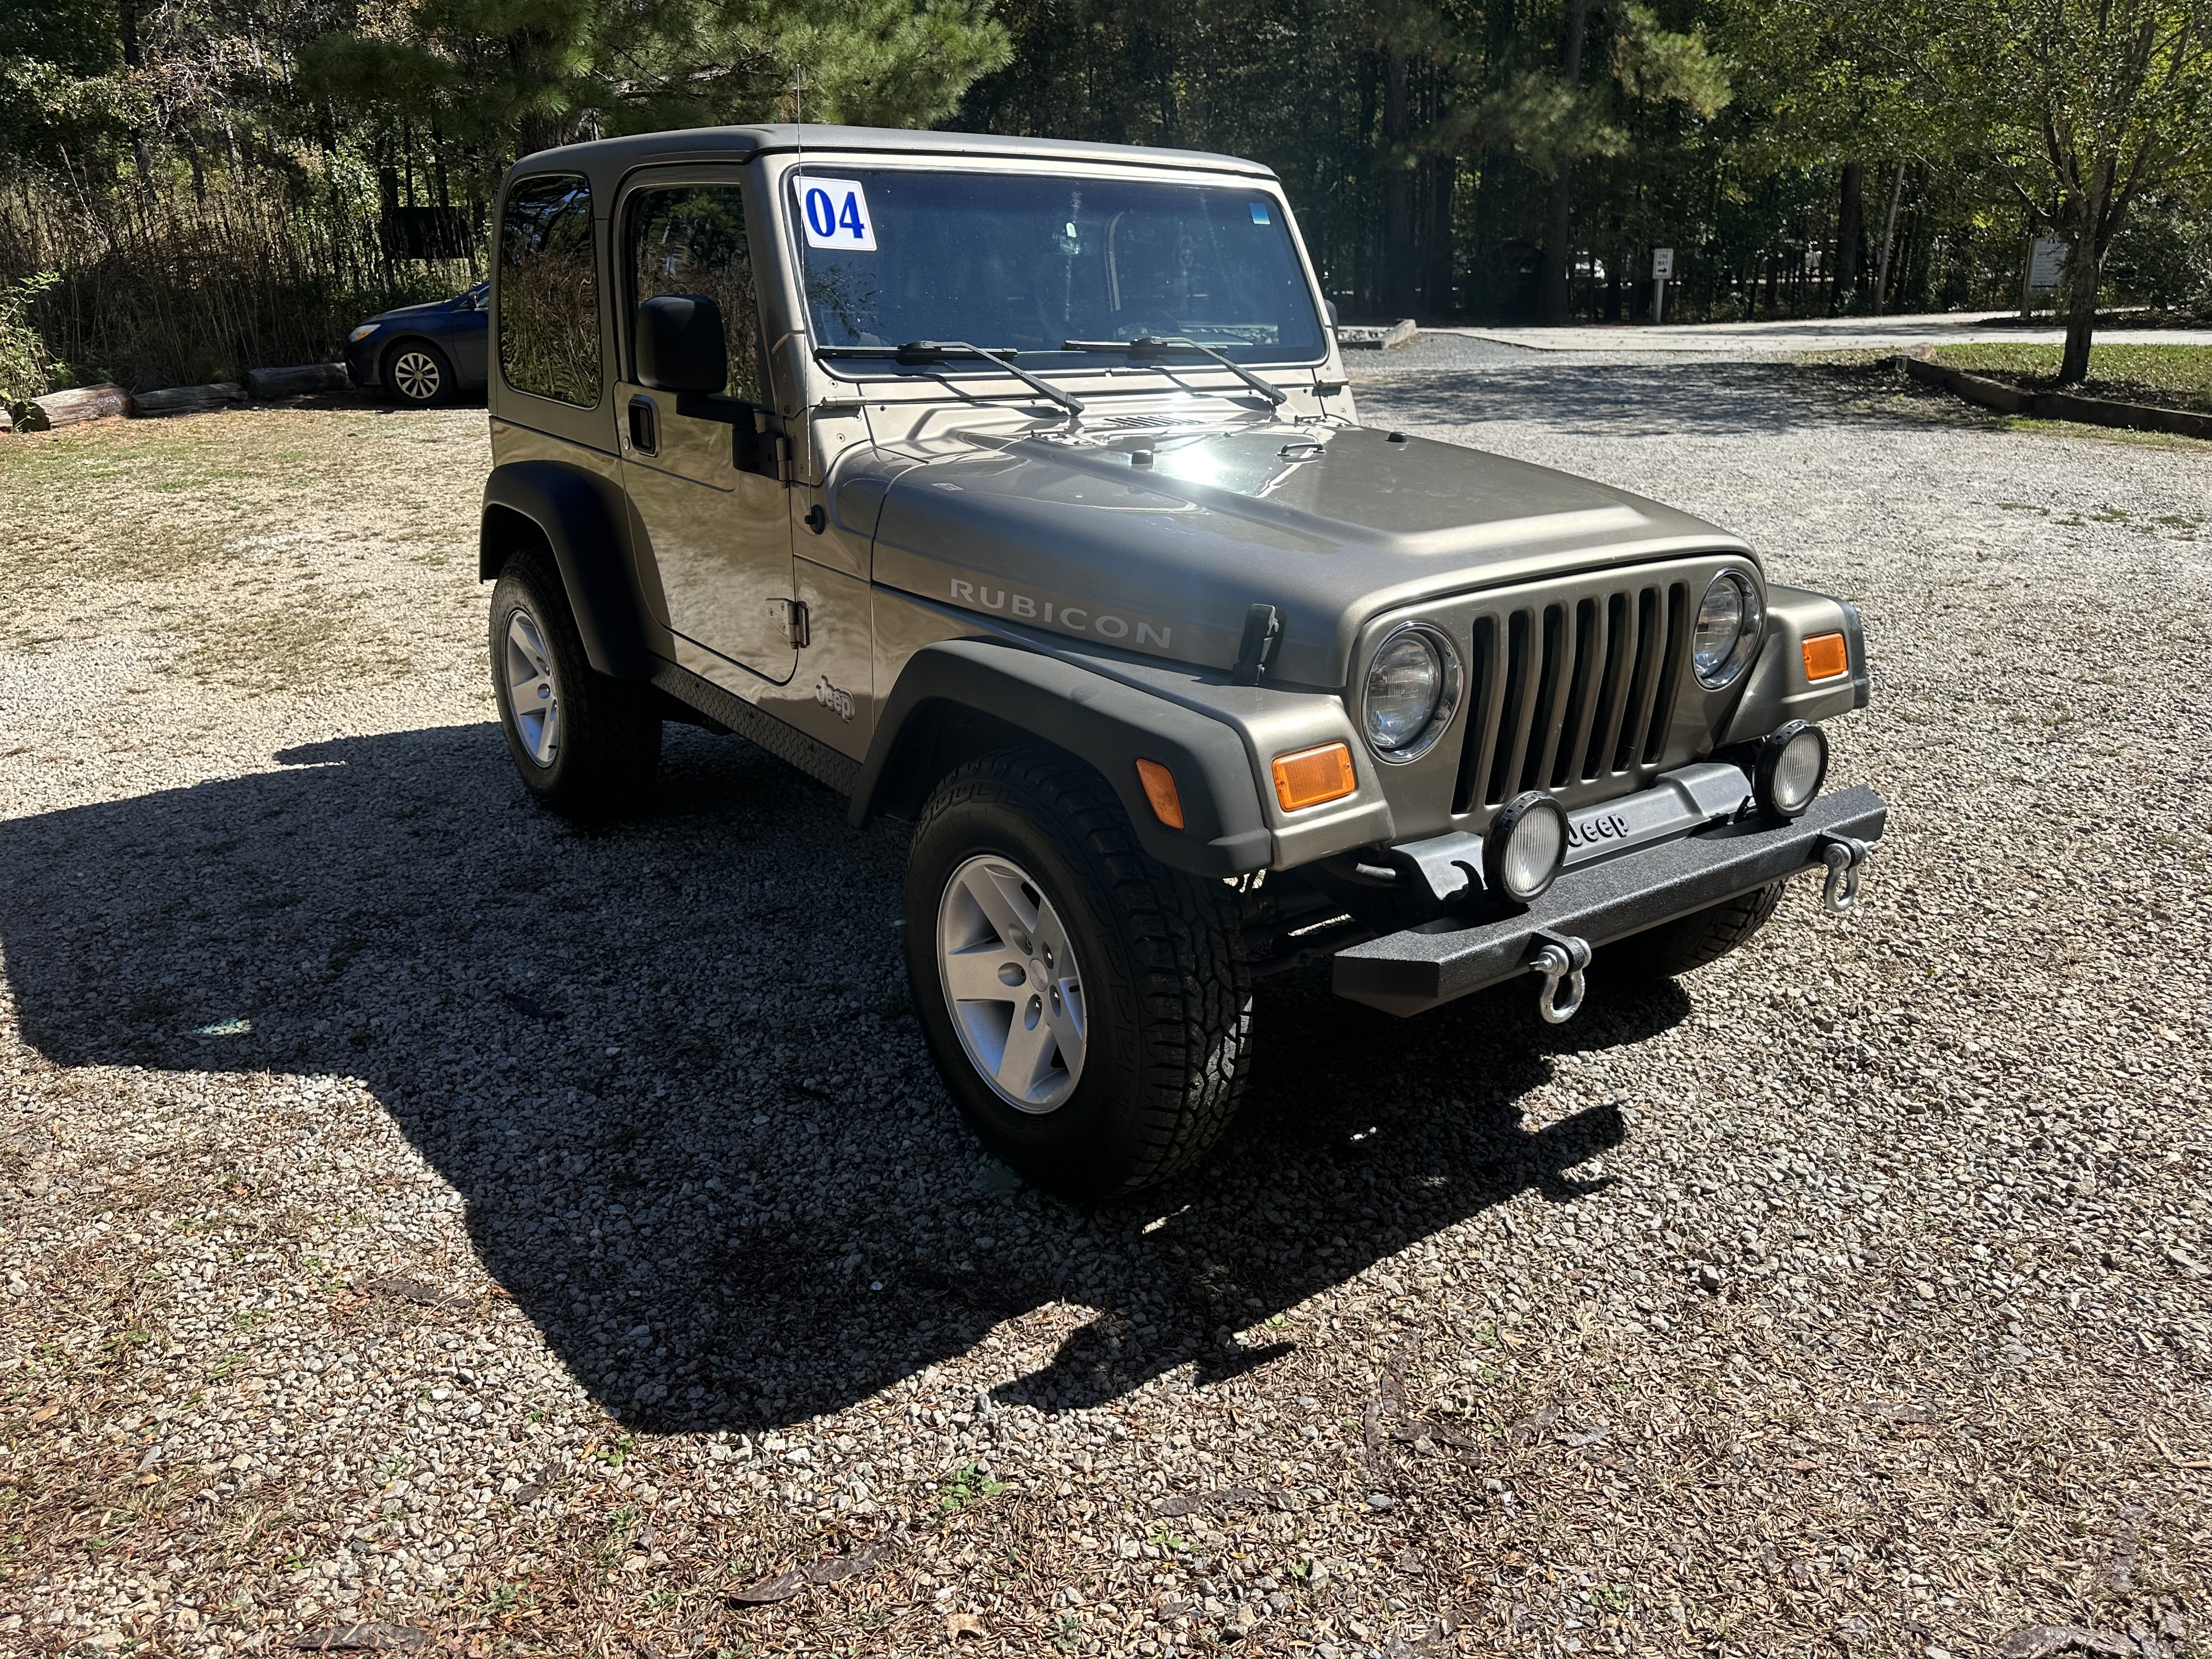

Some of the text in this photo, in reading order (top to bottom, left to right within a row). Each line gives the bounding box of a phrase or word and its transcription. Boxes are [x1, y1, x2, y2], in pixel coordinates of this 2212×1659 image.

[806, 188, 865, 239] 04
[950, 578, 1172, 650] RUBICON
[816, 675, 855, 723] Jeep
[1568, 814, 1629, 848] Jeep
